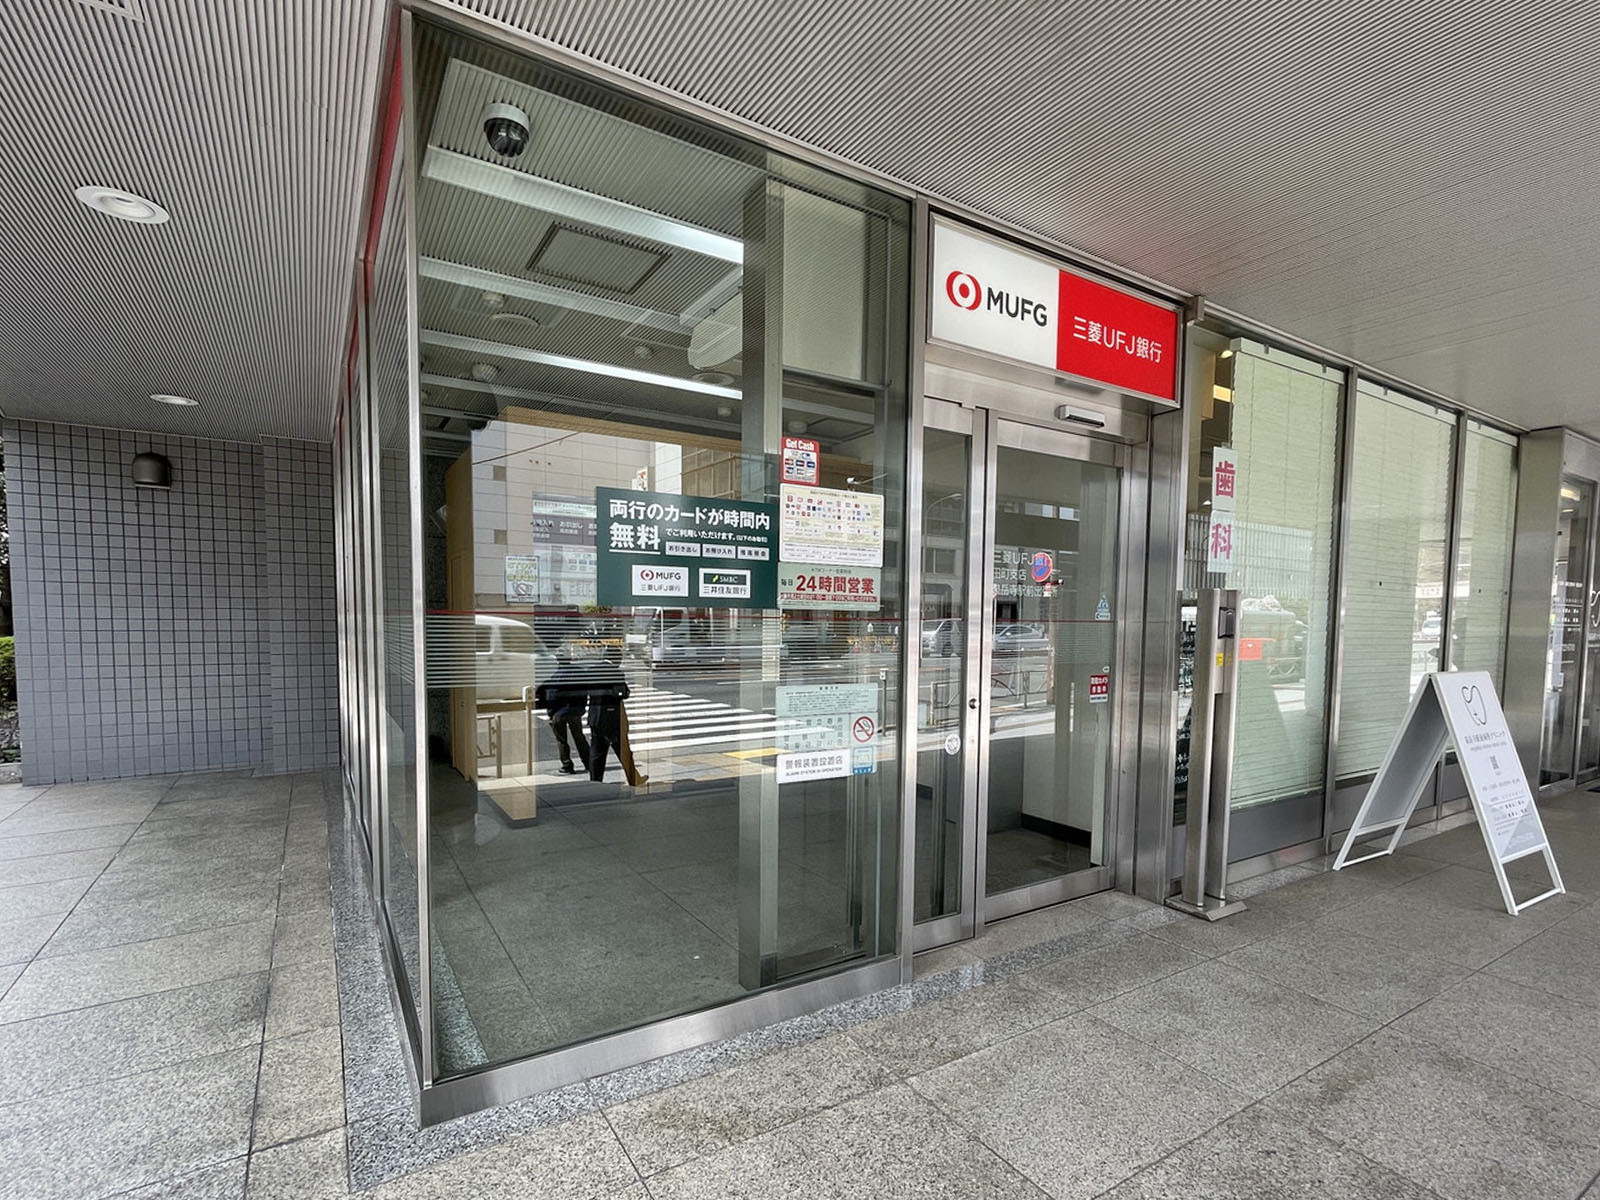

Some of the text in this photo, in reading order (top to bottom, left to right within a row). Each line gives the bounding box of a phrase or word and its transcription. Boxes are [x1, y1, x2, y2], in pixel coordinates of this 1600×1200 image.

[987, 287, 1047, 327] MUFG
[1073, 316, 1162, 363] 三菱UFJ銀行
[786, 438, 815, 451] Get Cash
[609, 499, 771, 531] 両行のカードが時間内
[1211, 460, 1236, 560] 歯科
[609, 521, 661, 550] 無料
[656, 571, 682, 580] MUFG
[719, 575, 738, 584] SMBC
[796, 574, 874, 594] 24時間営業
[703, 586, 747, 595] 三井住友銀行
